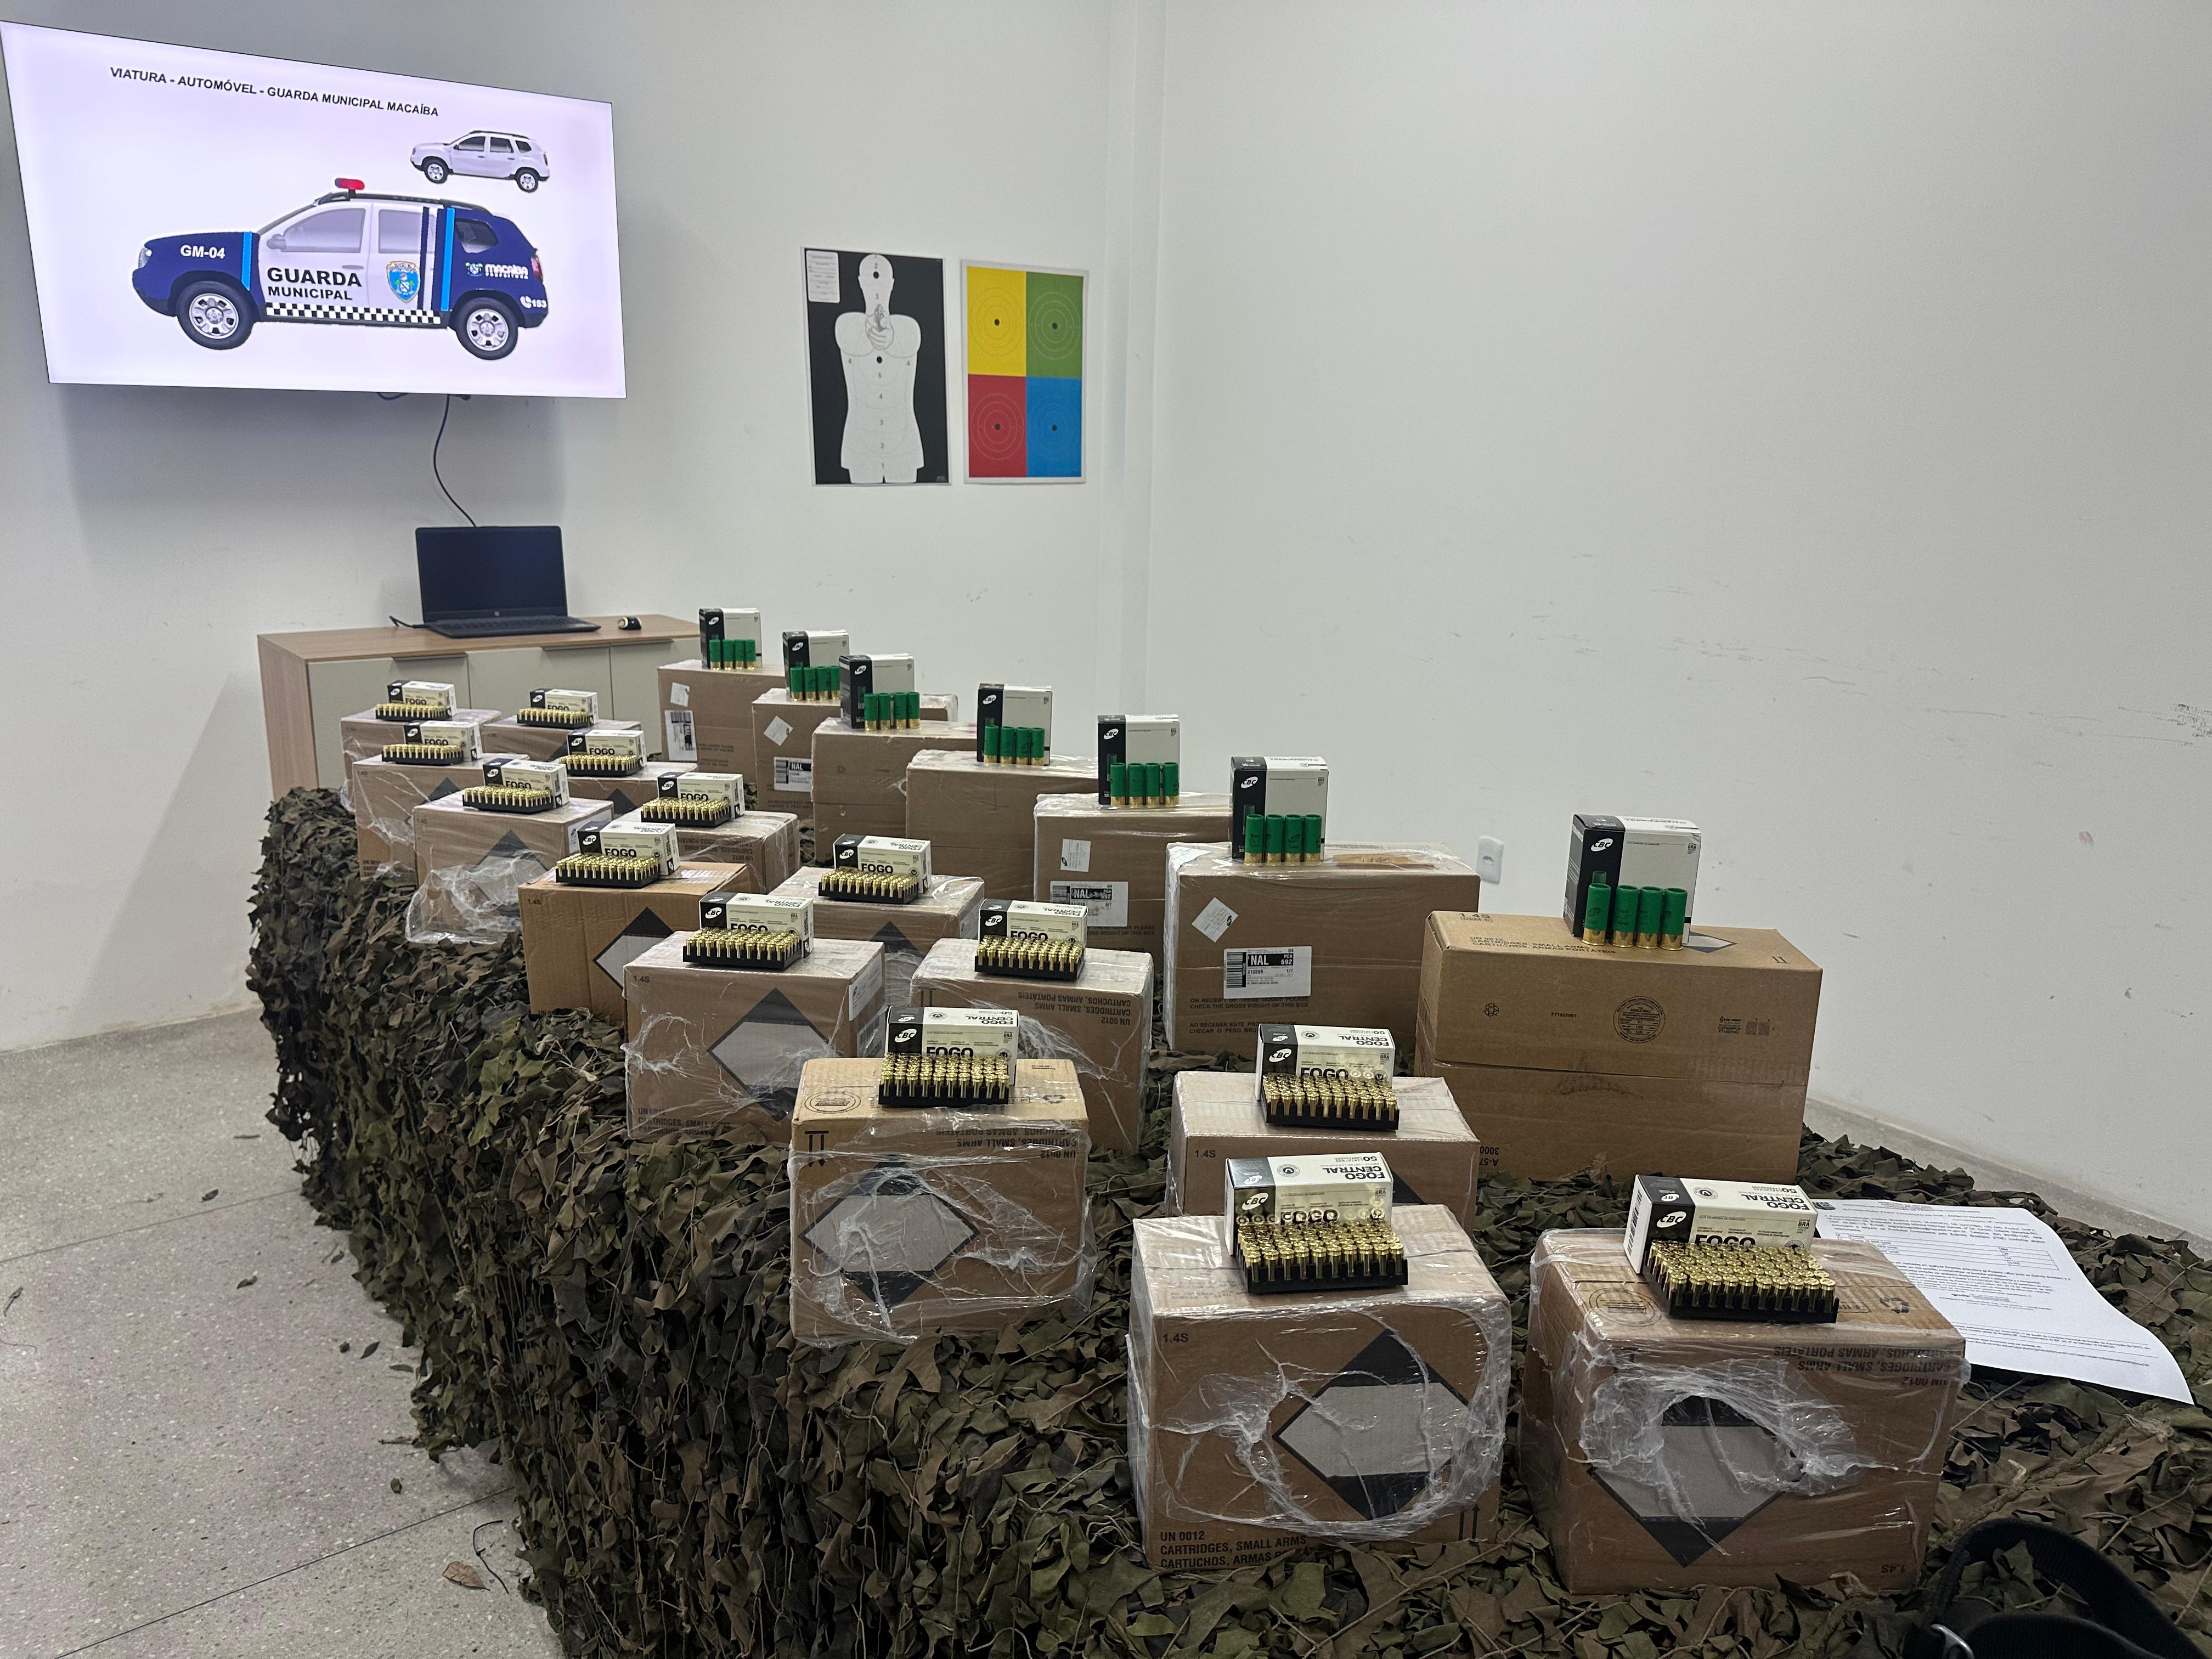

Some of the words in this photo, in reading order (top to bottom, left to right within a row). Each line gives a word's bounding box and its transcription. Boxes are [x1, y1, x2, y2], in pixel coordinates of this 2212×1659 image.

[110, 67, 166, 83] VIATURA
[177, 76, 257, 94] AUTOMÓVEL
[267, 87, 319, 102] GUARDA
[321, 94, 384, 110] MUNICIPAL
[387, 101, 439, 117] MACAÍBA
[180, 245, 225, 259] GM-04
[267, 267, 362, 288] GUARDA
[267, 287, 353, 300] MUNICIPAL
[532, 299, 547, 308] 153
[506, 780, 532, 788] FOGO
[605, 848, 637, 857] FOGO
[861, 863, 893, 873] FOGO
[731, 923, 768, 932] FOGO
[1010, 931, 1048, 940] FOGO
[1018, 991, 1056, 1001] PORTÁTEIS
[1057, 994, 1083, 1003] ARMAS
[1085, 996, 1131, 1006] CARTUCHOS,
[1057, 1004, 1080, 1012] SMALL
[1081, 1005, 1131, 1015] CARTRIDGES,
[1101, 1017, 1118, 1025] 0012
[926, 1047, 973, 1057] FOGO
[1301, 1068, 1348, 1079] FOGO
[957, 1138, 983, 1147] ARMS
[985, 1138, 1015, 1147] SMALL
[1064, 1149, 1076, 1158] UN
[1195, 1150, 1216, 1158] 1.4S
[1479, 1146, 1500, 1155] 3000
[1479, 1157, 1499, 1167] A-57
[1741, 1194, 1804, 1204] CENTRAL
[1767, 1201, 1810, 1210] FOGO
[1280, 1209, 1338, 1224] FOGO
[1695, 1234, 1756, 1246] FOGO
[1163, 1333, 1189, 1344] 1.4S
[1774, 1345, 1835, 1357] PORTÁTEIS
[1837, 1347, 1878, 1358] ARMAS
[1830, 1360, 1874, 1372] SMALL
[1877, 1360, 1950, 1373] CARTRIDGES,
[1160, 1531, 1177, 1541] UN
[1180, 1530, 1205, 1541] 0012
[1160, 1542, 1232, 1556] CARTRIDGES,
[1236, 1538, 1272, 1551] SMALL
[1275, 1536, 1307, 1548] ARMS
[1160, 1554, 1231, 1568] CARTUCHOS,
[1234, 1551, 1271, 1565] ARMAS
[1881, 1564, 1905, 1573] 1.4S
